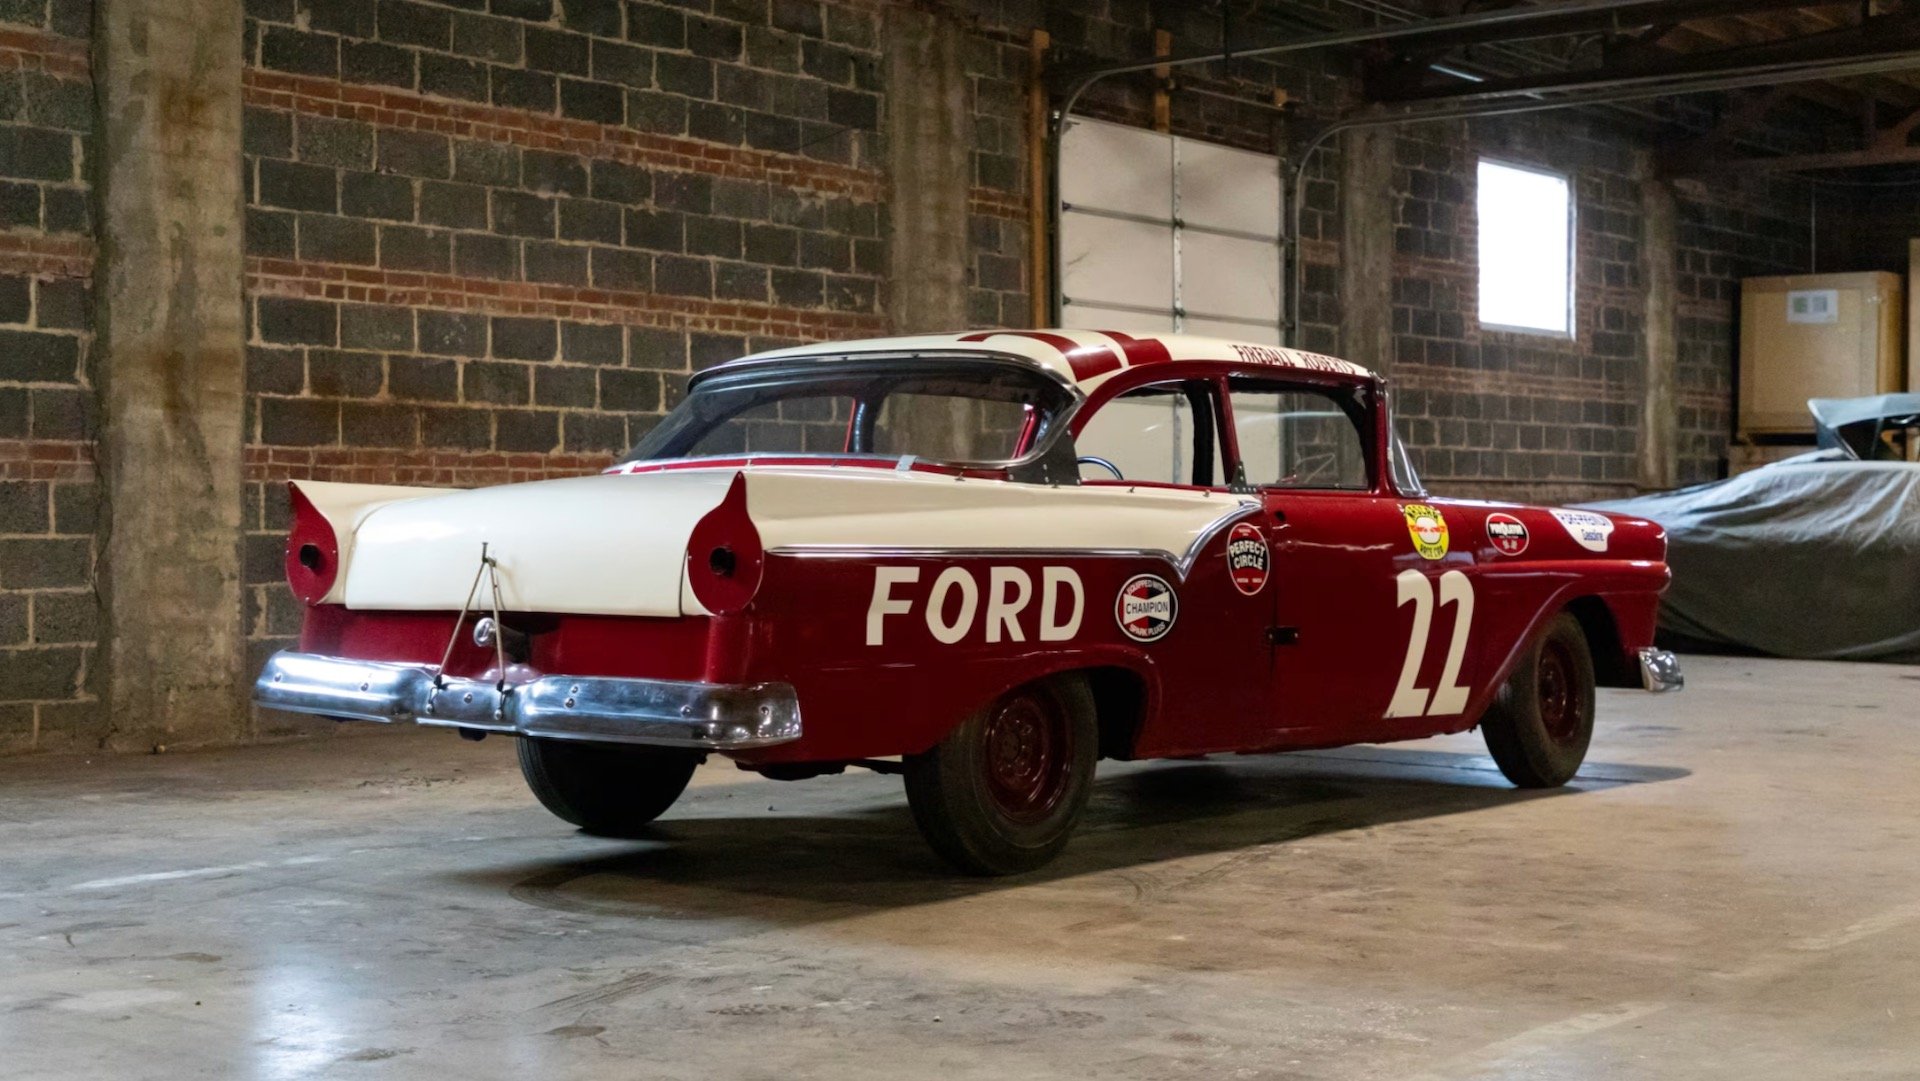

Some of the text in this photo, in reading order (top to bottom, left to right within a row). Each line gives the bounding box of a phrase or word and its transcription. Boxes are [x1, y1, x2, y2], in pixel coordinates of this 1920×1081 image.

[1229, 540, 1266, 557] PERFECT
[1233, 555, 1264, 570] CIRCLE
[866, 566, 1085, 645] FORD
[1125, 602, 1168, 615] CHAMPION
[1382, 569, 1475, 719] 22
